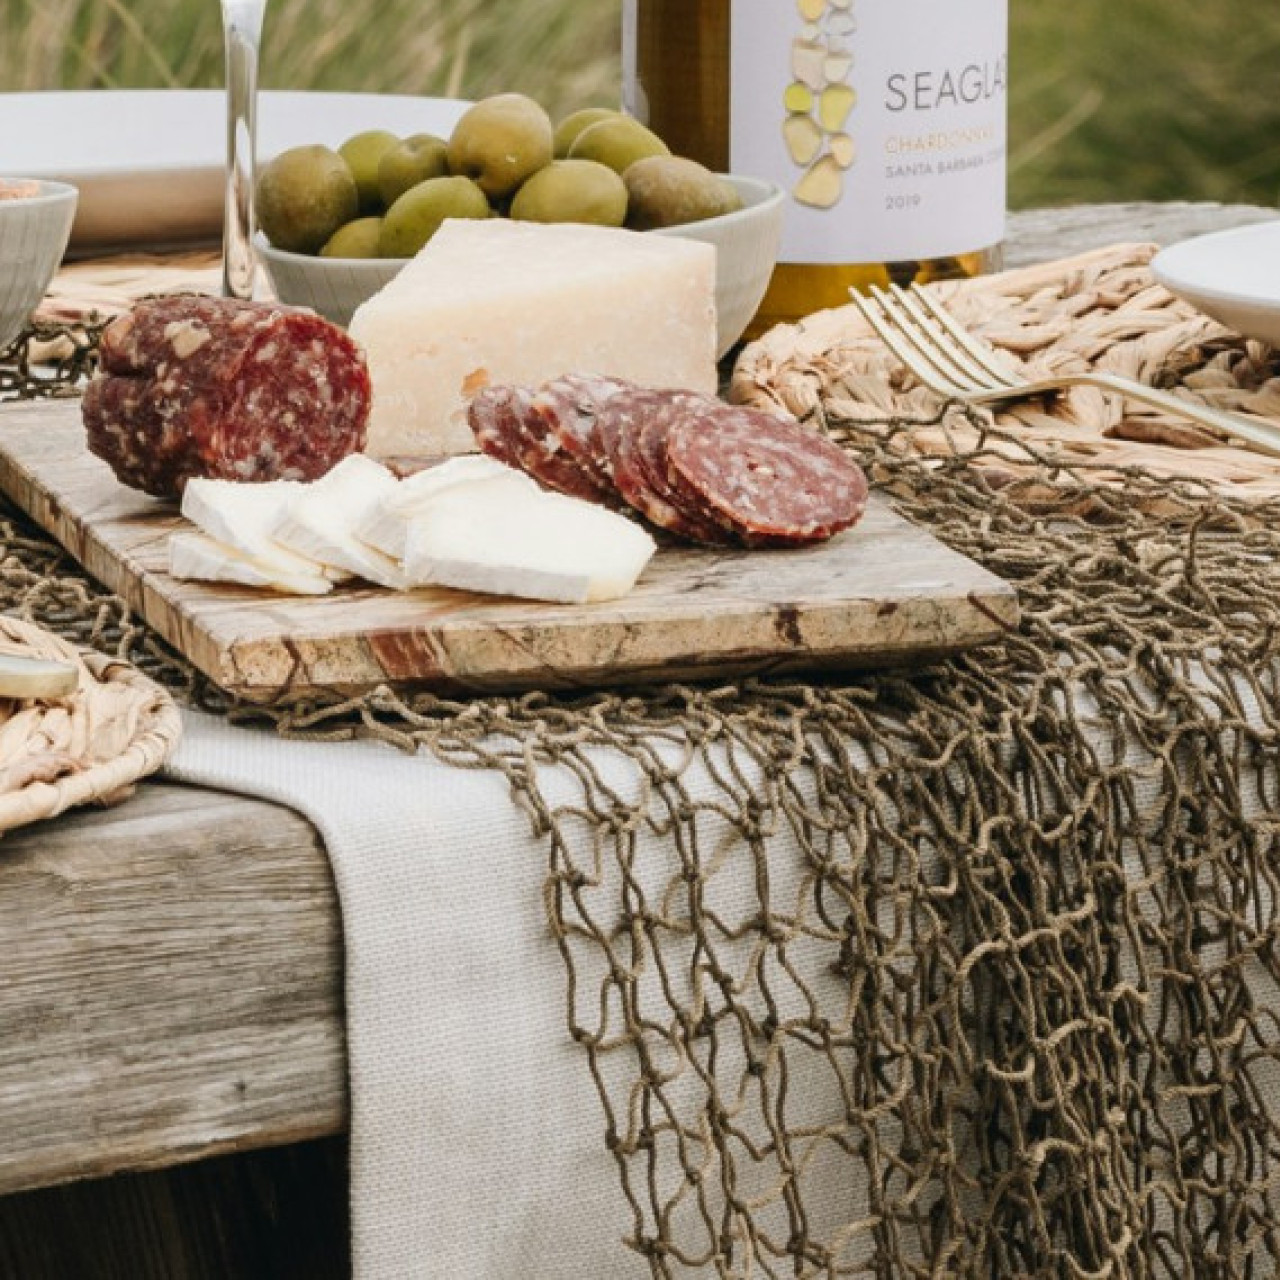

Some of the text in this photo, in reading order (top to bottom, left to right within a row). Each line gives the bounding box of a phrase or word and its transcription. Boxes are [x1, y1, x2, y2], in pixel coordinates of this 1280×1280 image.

[885, 56, 1006, 112] SEAGLA
[885, 161, 933, 179] SANTA
[885, 192, 921, 211] 2019
